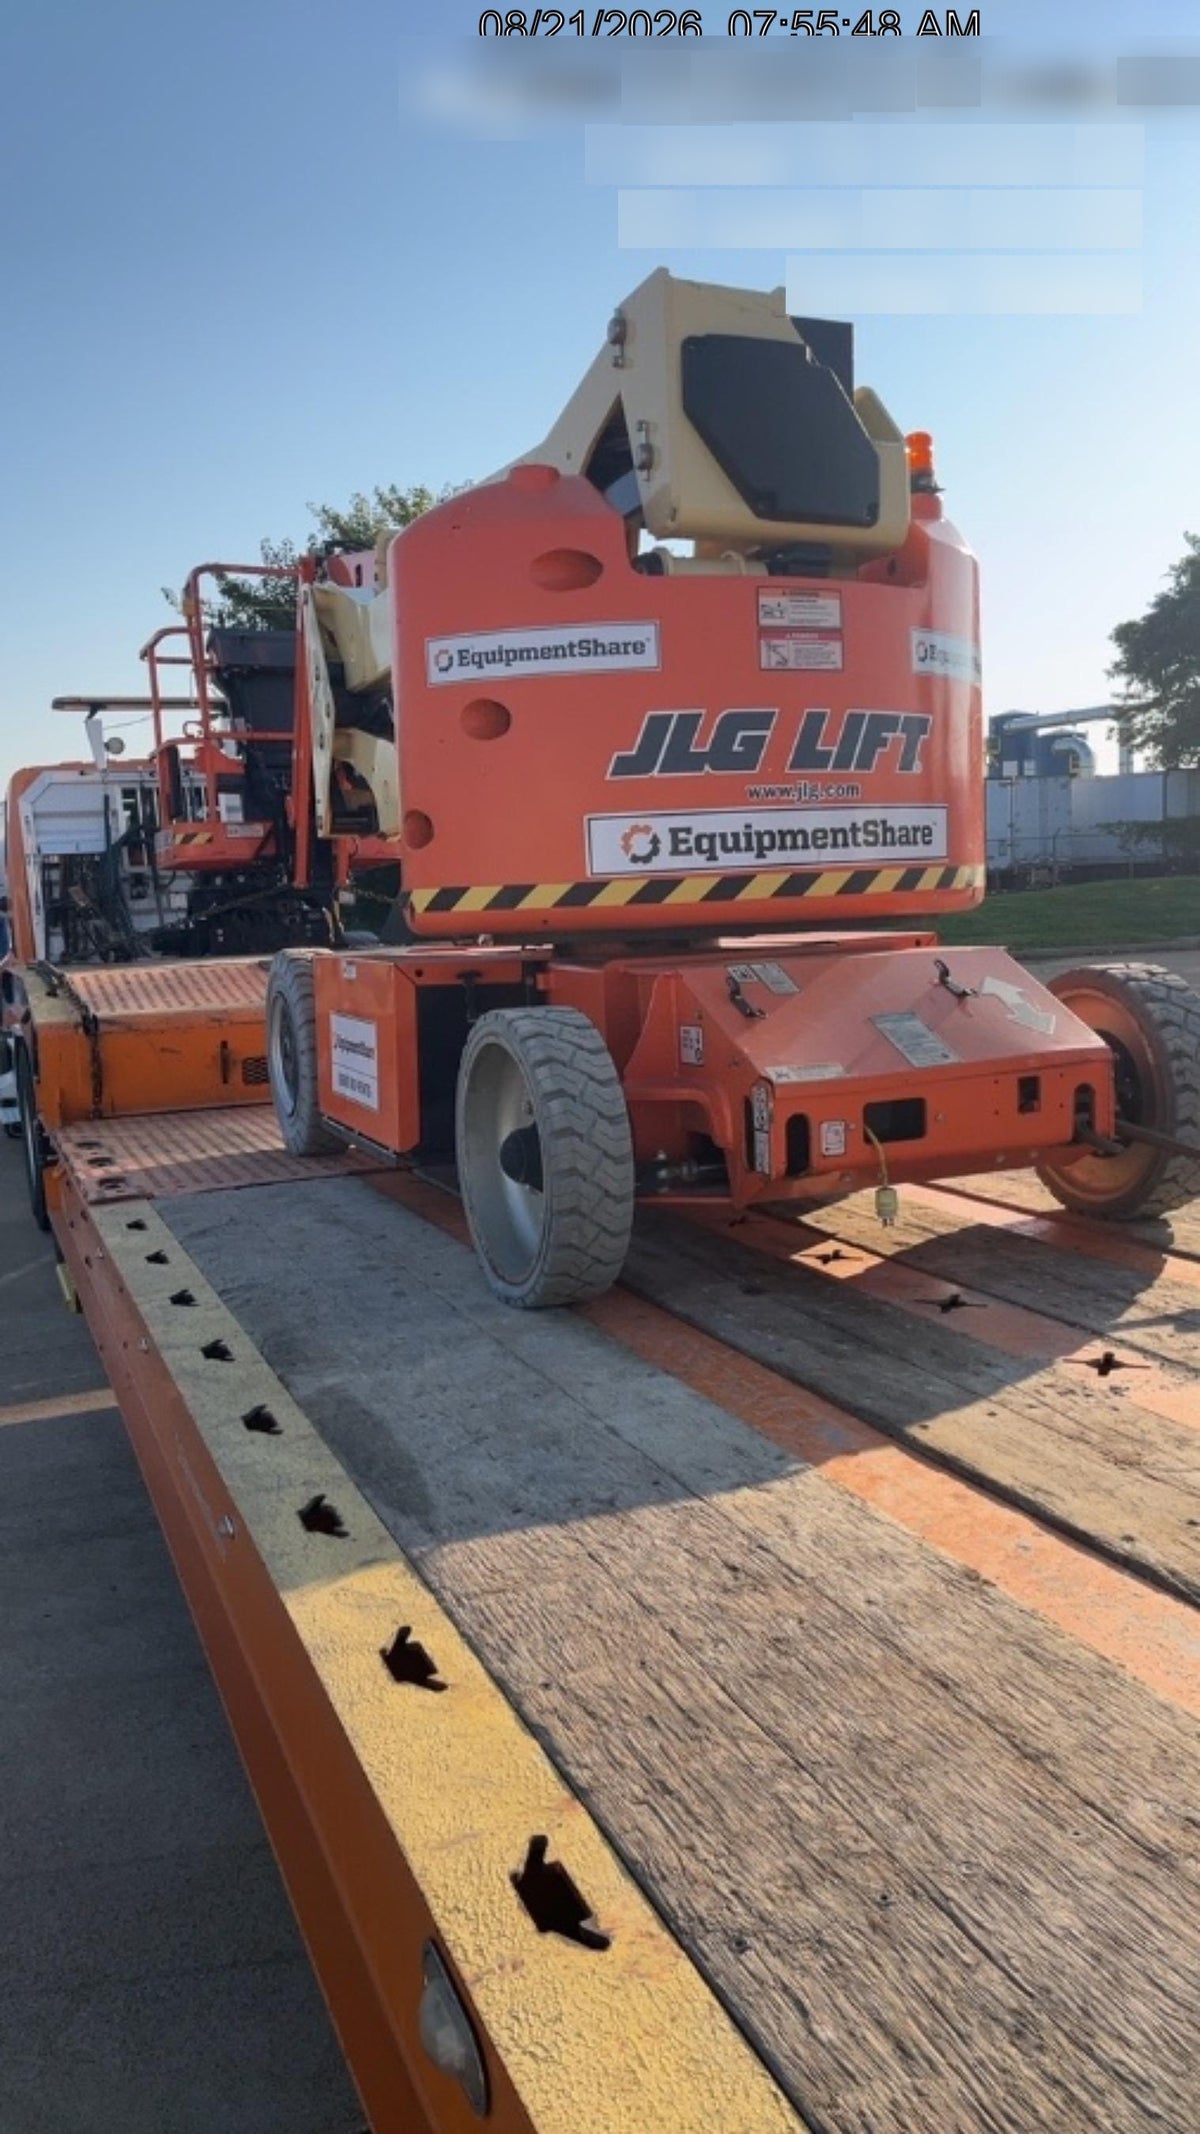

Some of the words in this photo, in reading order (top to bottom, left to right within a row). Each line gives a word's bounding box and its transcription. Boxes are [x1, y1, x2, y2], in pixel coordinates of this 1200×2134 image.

[457, 638, 647, 669] EquipmentShare
[606, 710, 777, 779] JLG
[786, 709, 932, 773] LIFT
[746, 781, 860, 801] www.jlg.com
[668, 820, 933, 861] EquipmentShare
